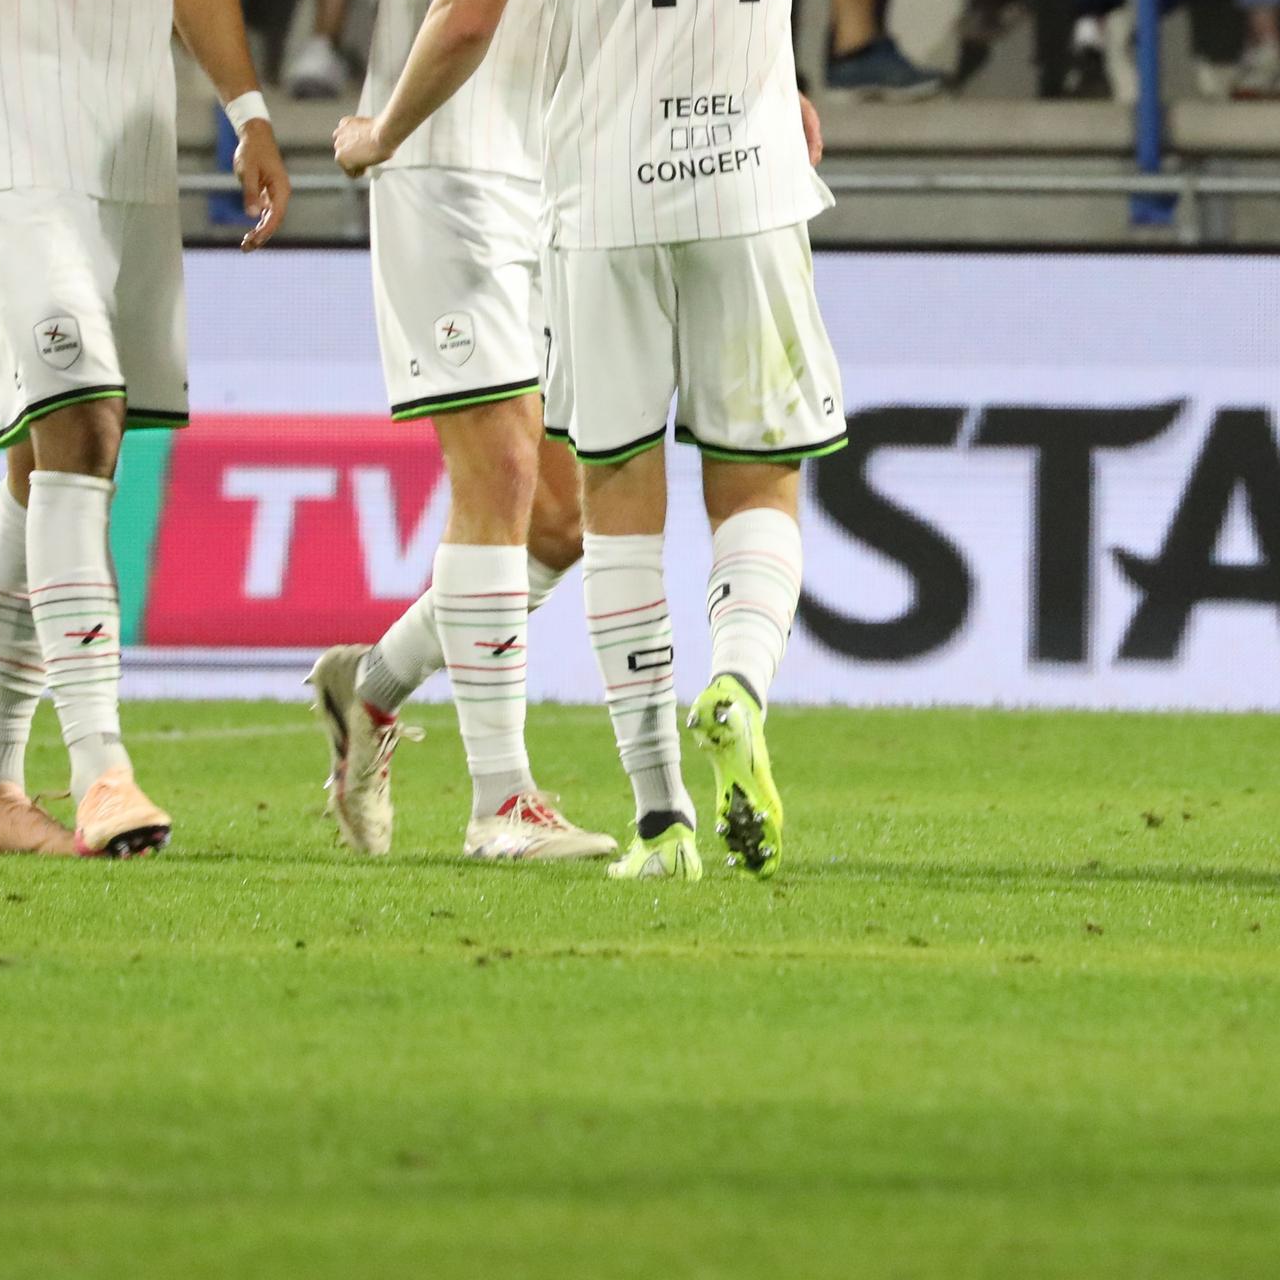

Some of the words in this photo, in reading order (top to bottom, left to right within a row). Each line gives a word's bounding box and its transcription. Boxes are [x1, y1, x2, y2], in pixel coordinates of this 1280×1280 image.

[659, 94, 742, 120] TEGEL
[637, 146, 763, 184] CONCEPT
[222, 466, 450, 600] TV
